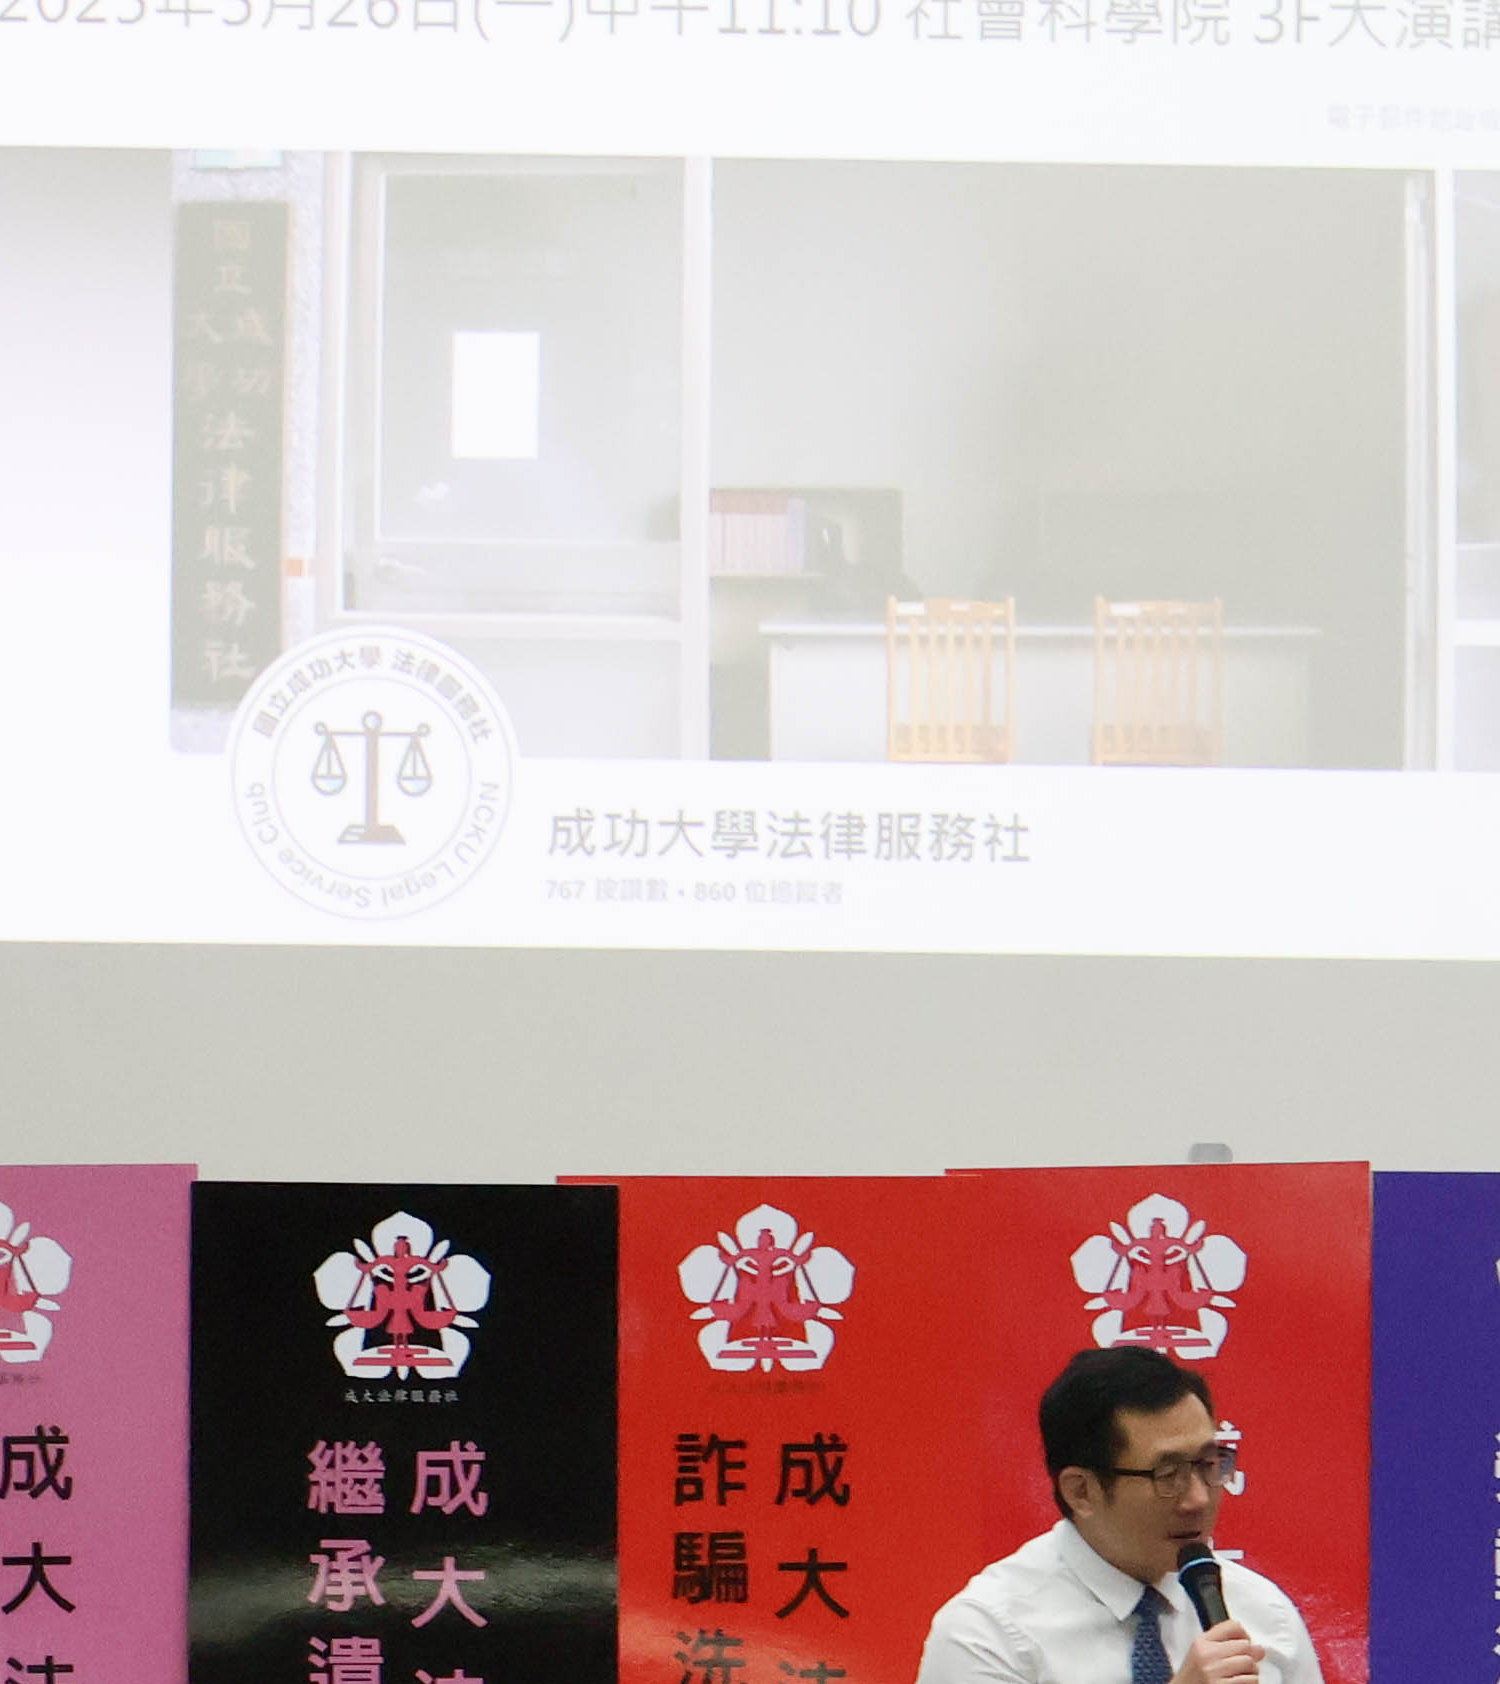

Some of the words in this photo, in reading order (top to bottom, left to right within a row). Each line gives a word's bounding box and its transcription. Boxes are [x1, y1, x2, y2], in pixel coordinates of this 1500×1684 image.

[905, 0, 1231, 47] 社會科學院
[546, 806, 1032, 864] 成功大學法律服務社
